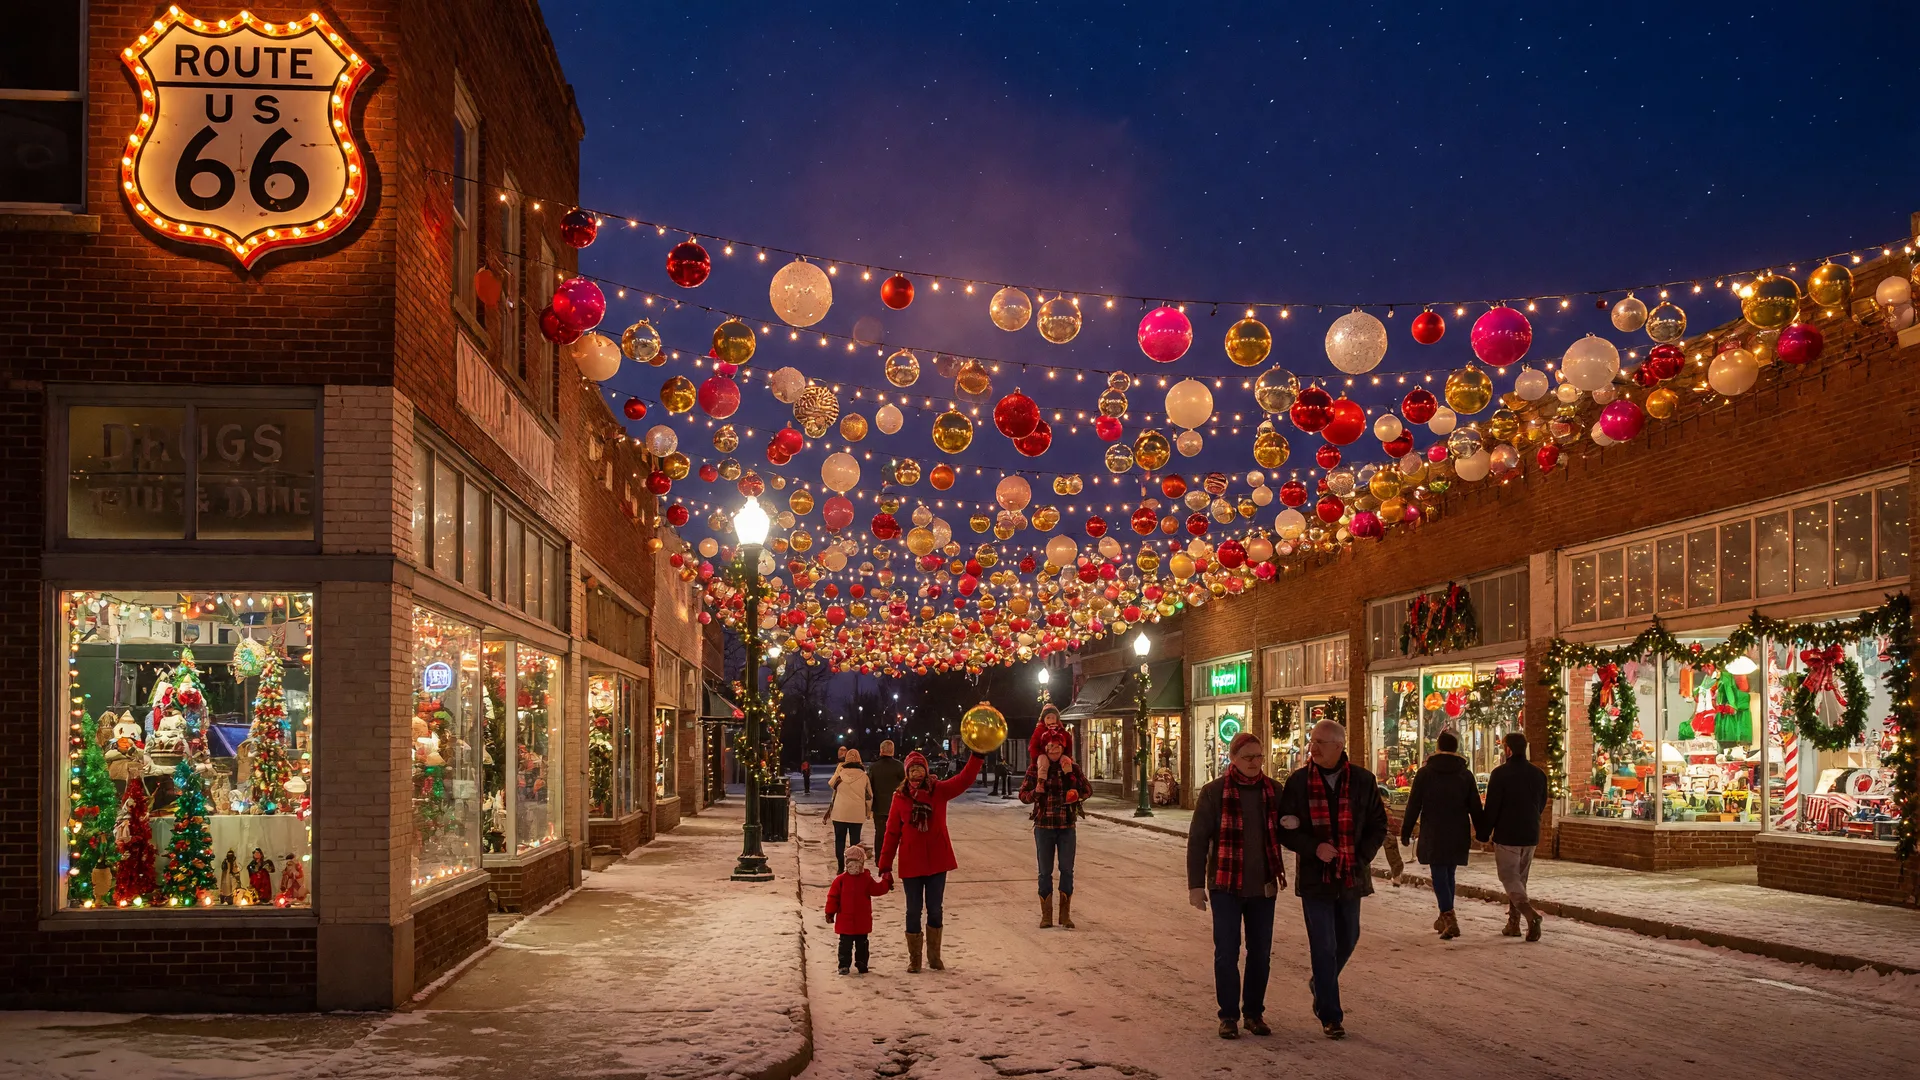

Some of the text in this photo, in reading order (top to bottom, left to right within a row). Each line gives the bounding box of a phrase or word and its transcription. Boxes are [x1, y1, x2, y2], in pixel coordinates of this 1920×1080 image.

[174, 44, 313, 80] ROUTE
[174, 125, 310, 213] 66
[101, 423, 284, 463] DRUGS
